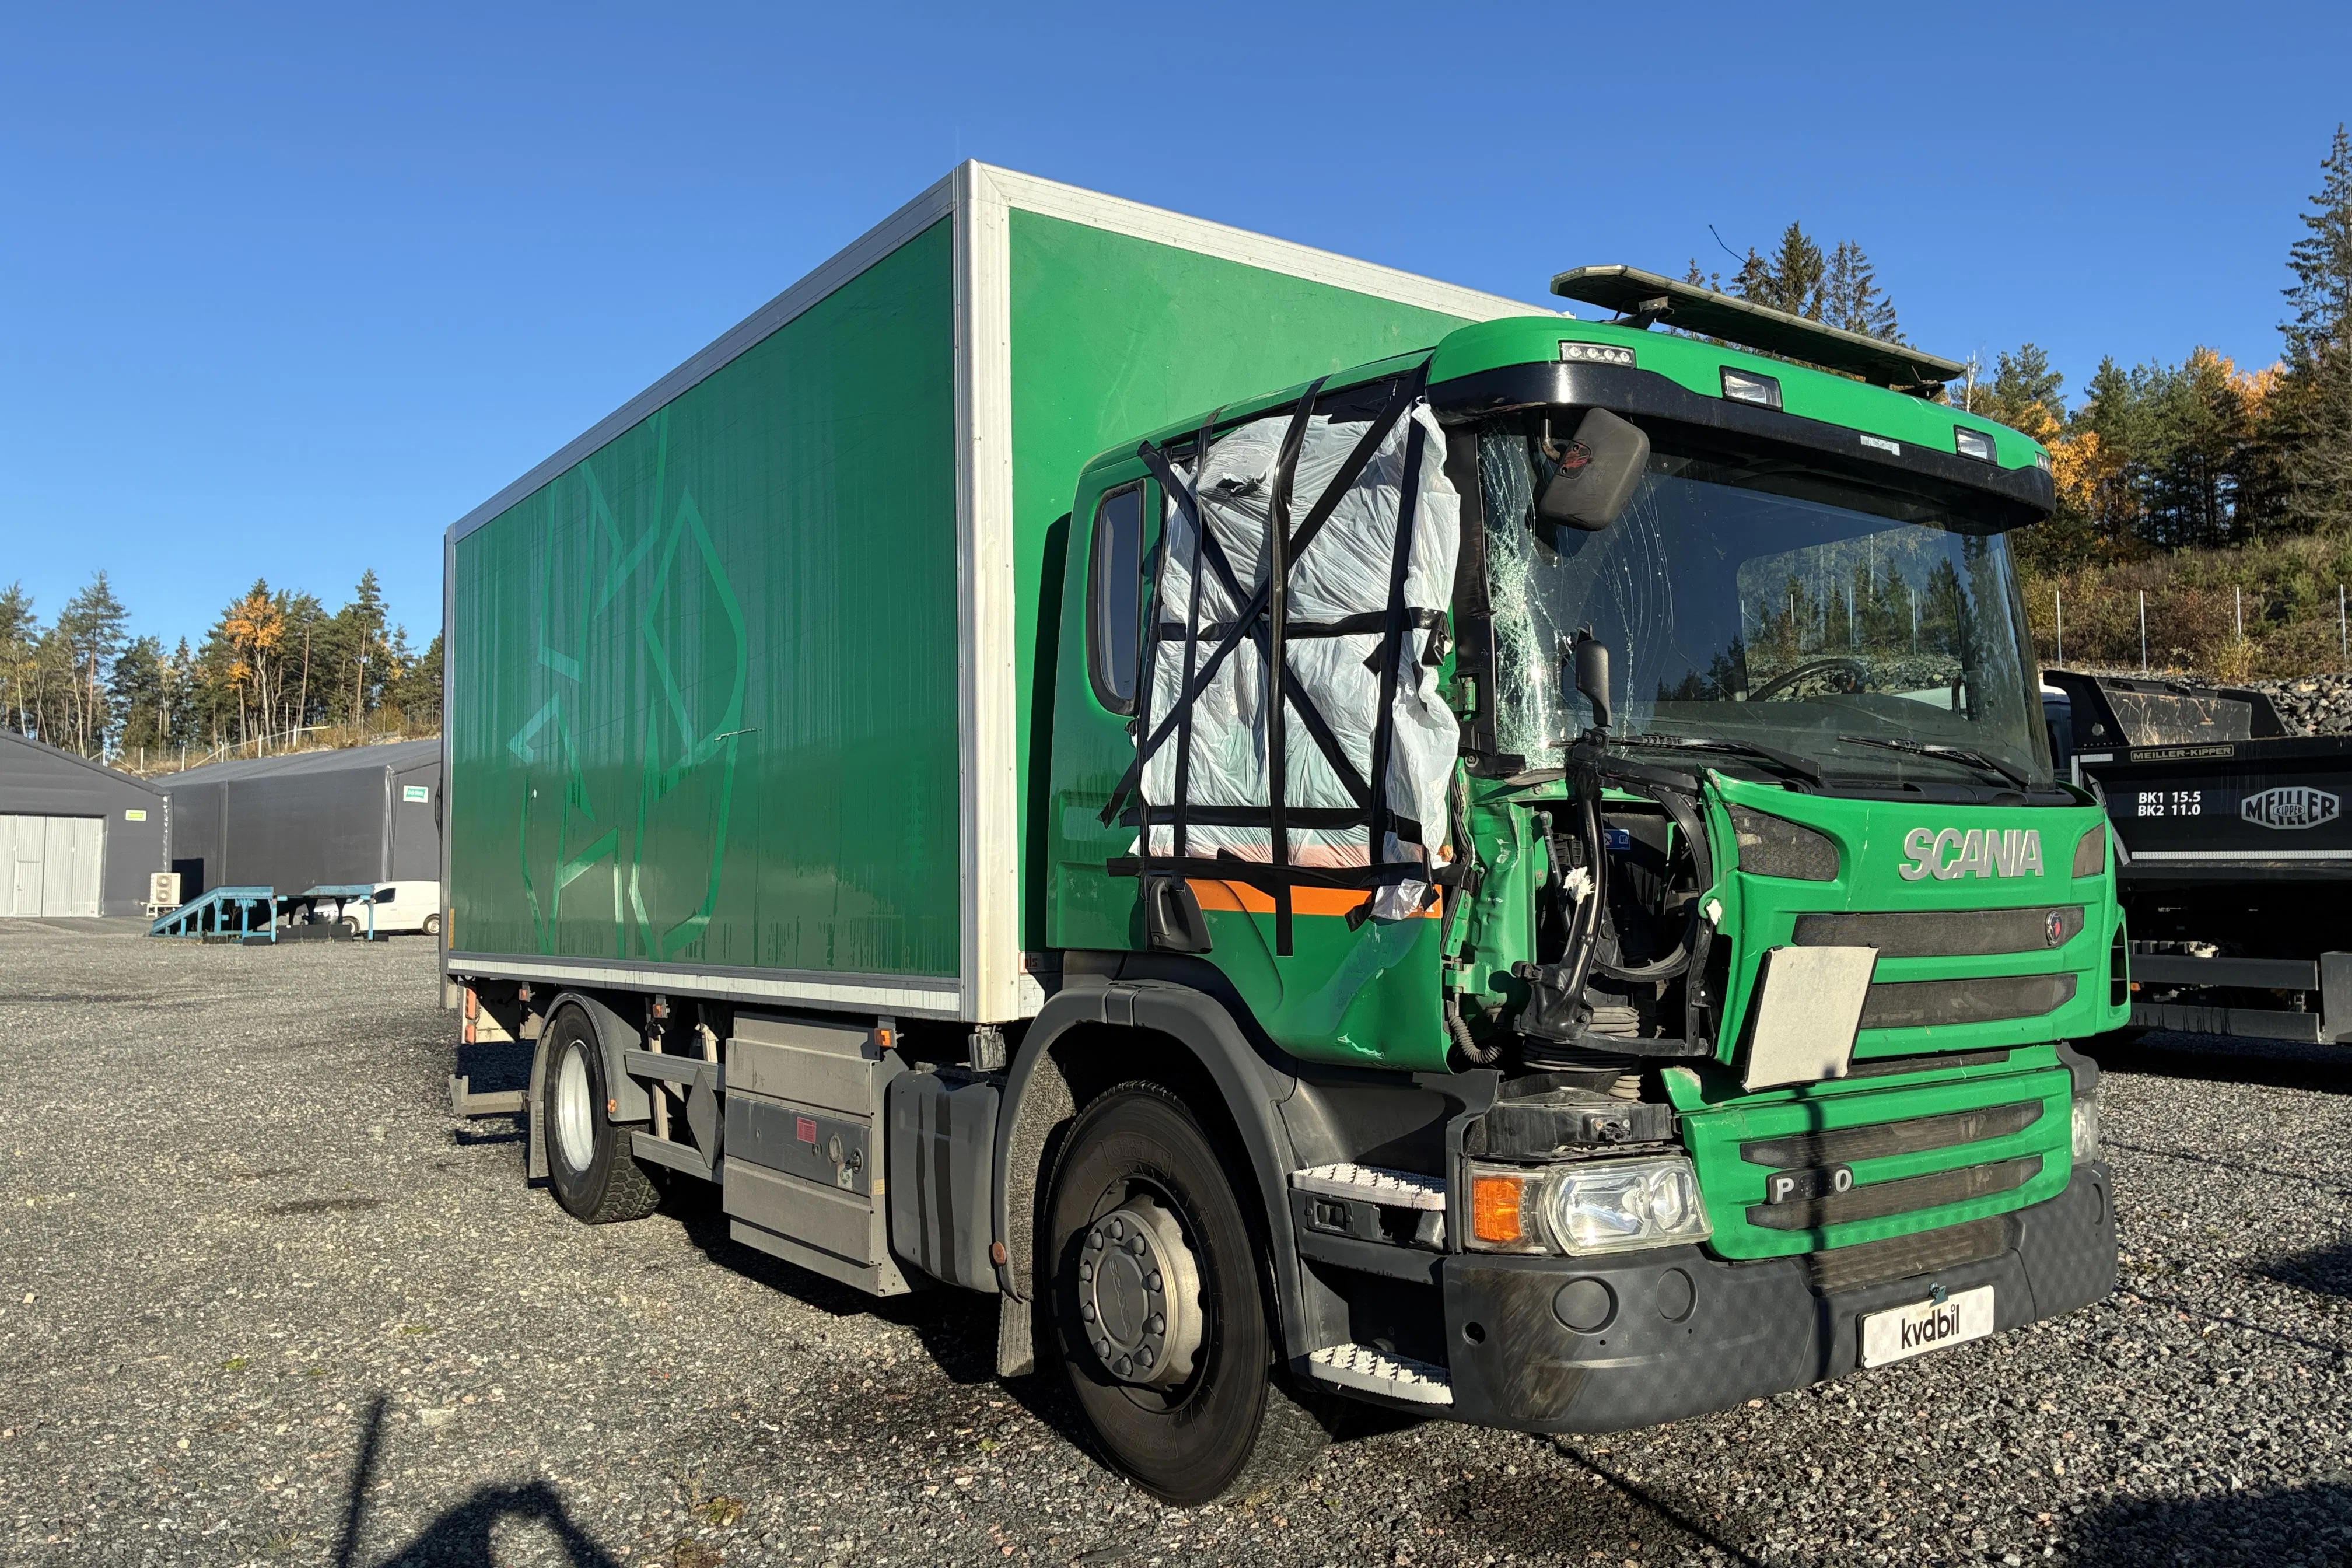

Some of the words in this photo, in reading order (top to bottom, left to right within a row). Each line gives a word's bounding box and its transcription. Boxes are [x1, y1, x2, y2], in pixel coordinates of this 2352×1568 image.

[2133, 747, 2231, 760] MEILLER-KIPPER
[2138, 792, 2164, 804] BK1
[2172, 790, 2201, 803] 15.5
[2245, 790, 2335, 826] MEILLER
[2137, 804, 2164, 817] BK2
[2171, 803, 2201, 816] 11.0
[2276, 805, 2303, 816] KIPPER
[1899, 827, 2044, 881] SCANIA
[1776, 1177, 1795, 1202] P
[1108, 1258, 1133, 1340] SCANIA
[1901, 1304, 1960, 1350] kvdbil
